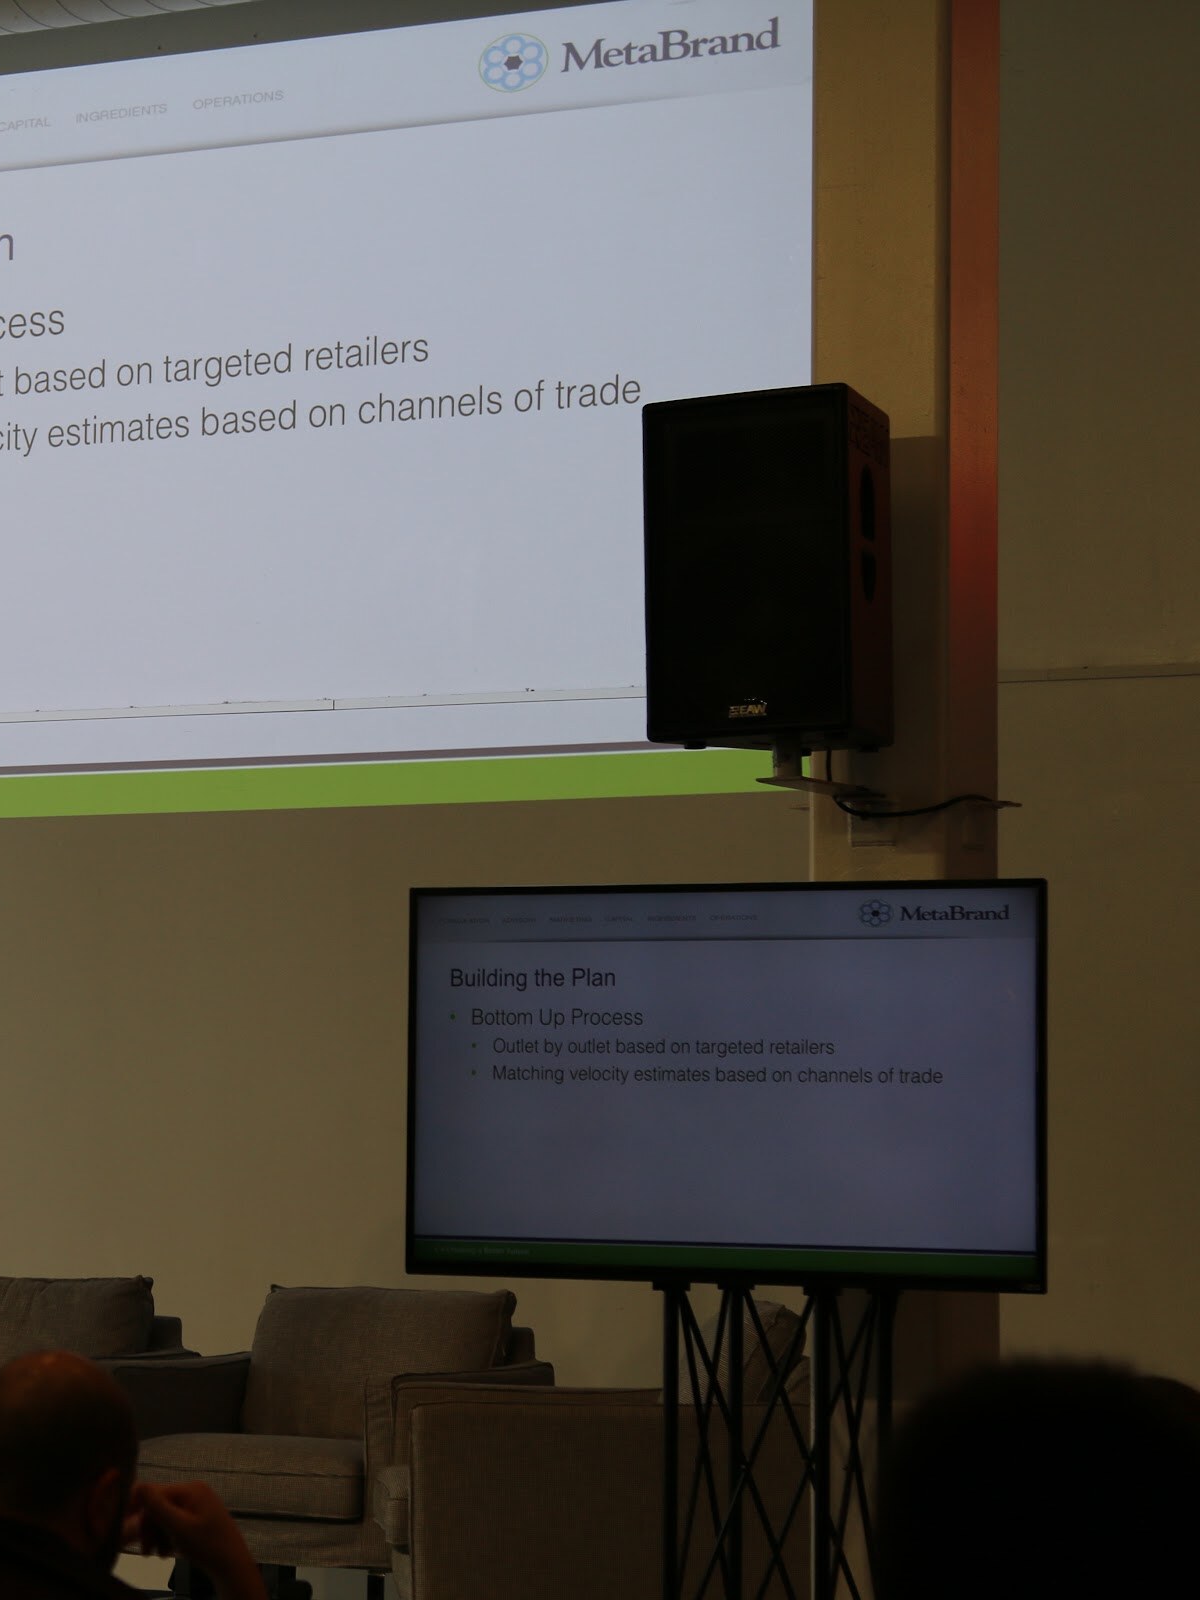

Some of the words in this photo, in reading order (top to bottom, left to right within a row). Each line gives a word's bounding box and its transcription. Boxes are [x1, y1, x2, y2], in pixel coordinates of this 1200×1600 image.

[561, 16, 781, 72] MetaBrand
[76, 104, 167, 123] INGREDIENTS
[193, 90, 284, 109] OPERATIONS
[16, 359, 105, 394] based
[117, 363, 151, 386] on
[164, 343, 291, 387] targeted
[306, 336, 428, 371] retailers
[48, 413, 189, 447] estimates
[202, 400, 296, 435] based
[309, 404, 344, 427] on
[359, 385, 502, 424] channels
[515, 380, 544, 412] of
[556, 374, 640, 409] trade
[901, 904, 1010, 921] MetaBrand
[451, 968, 527, 991] Building
[534, 968, 564, 986] the
[572, 968, 615, 986] Plan
[472, 1008, 532, 1025] Bottom
[540, 1009, 565, 1029] Up
[572, 1008, 643, 1025] Process
[493, 1038, 539, 1053] Outlet
[544, 1038, 563, 1057] by
[568, 1038, 610, 1054] outlet
[616, 1038, 665, 1054] based
[671, 1042, 690, 1054] on
[696, 1039, 763, 1058] targeted
[770, 1039, 834, 1054] retailers
[493, 1065, 564, 1084] Matching
[570, 1066, 629, 1085] velocity
[634, 1067, 710, 1082] estimates
[716, 1067, 766, 1082] based
[771, 1071, 792, 1082] on
[798, 1067, 872, 1083] channels
[878, 1067, 894, 1083] of
[900, 1068, 943, 1084] trade
